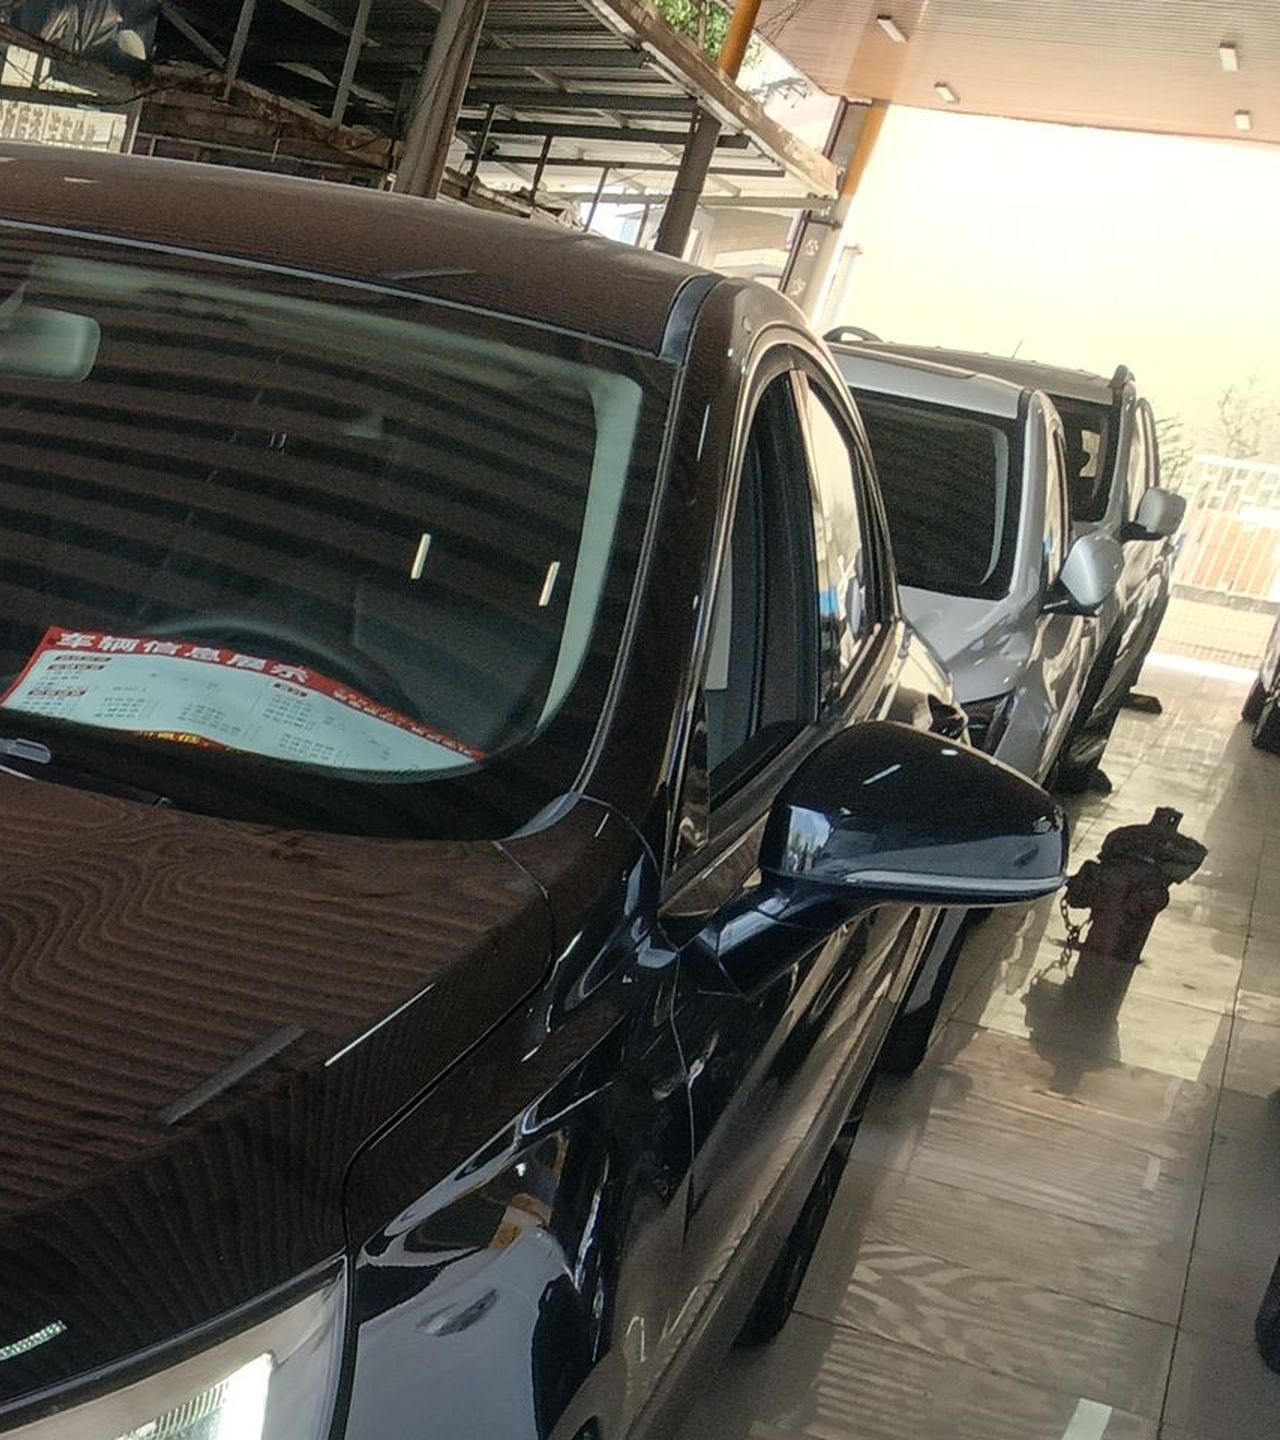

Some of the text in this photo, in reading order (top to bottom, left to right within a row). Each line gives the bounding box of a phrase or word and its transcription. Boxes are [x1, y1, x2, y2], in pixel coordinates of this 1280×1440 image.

[57, 632, 309, 683] 车辆信息展示
